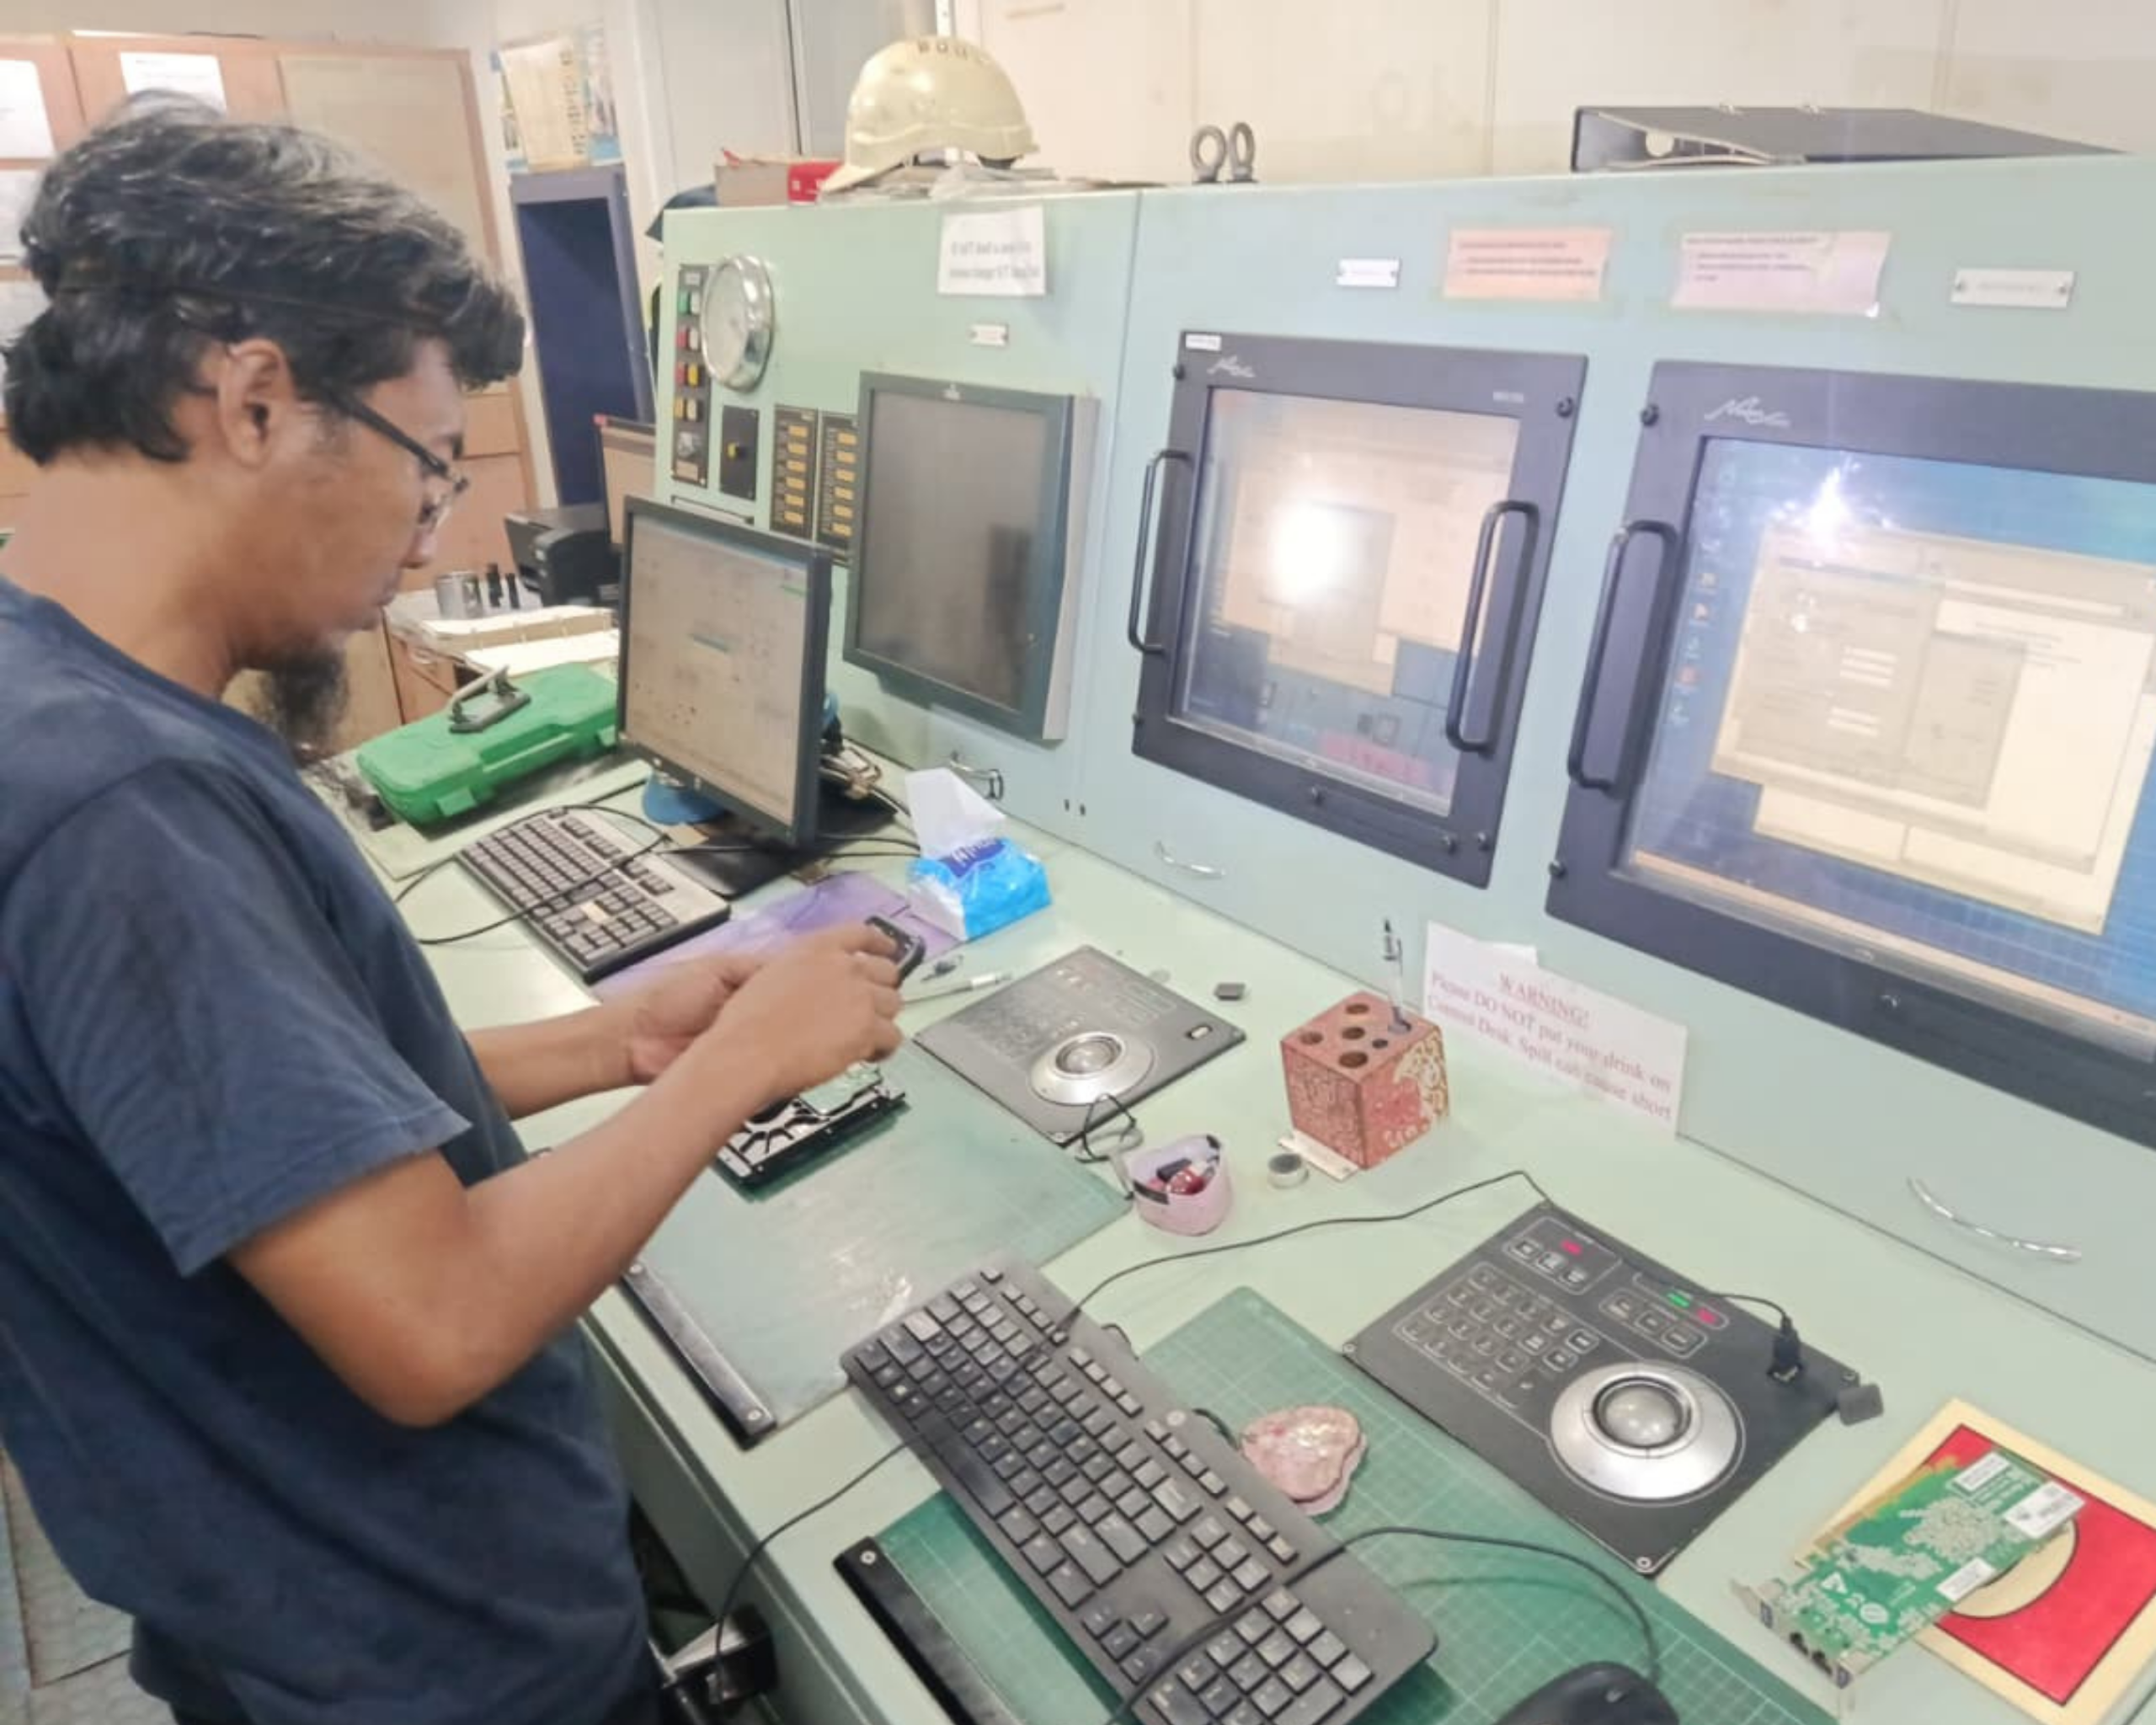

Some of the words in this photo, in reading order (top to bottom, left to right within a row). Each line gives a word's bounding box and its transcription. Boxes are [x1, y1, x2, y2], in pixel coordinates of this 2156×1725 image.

[1498, 972, 1591, 1028] WARNING!
[1475, 991, 1497, 1012] DO
[1501, 1000, 1536, 1029] NOT
[1539, 1020, 1562, 1044] put
[1566, 1037, 1600, 1060] your
[1604, 1049, 1645, 1079] drink
[1649, 1074, 1672, 1093] on
[1518, 1037, 1552, 1065] Spill
[1632, 1091, 1672, 1119] short
